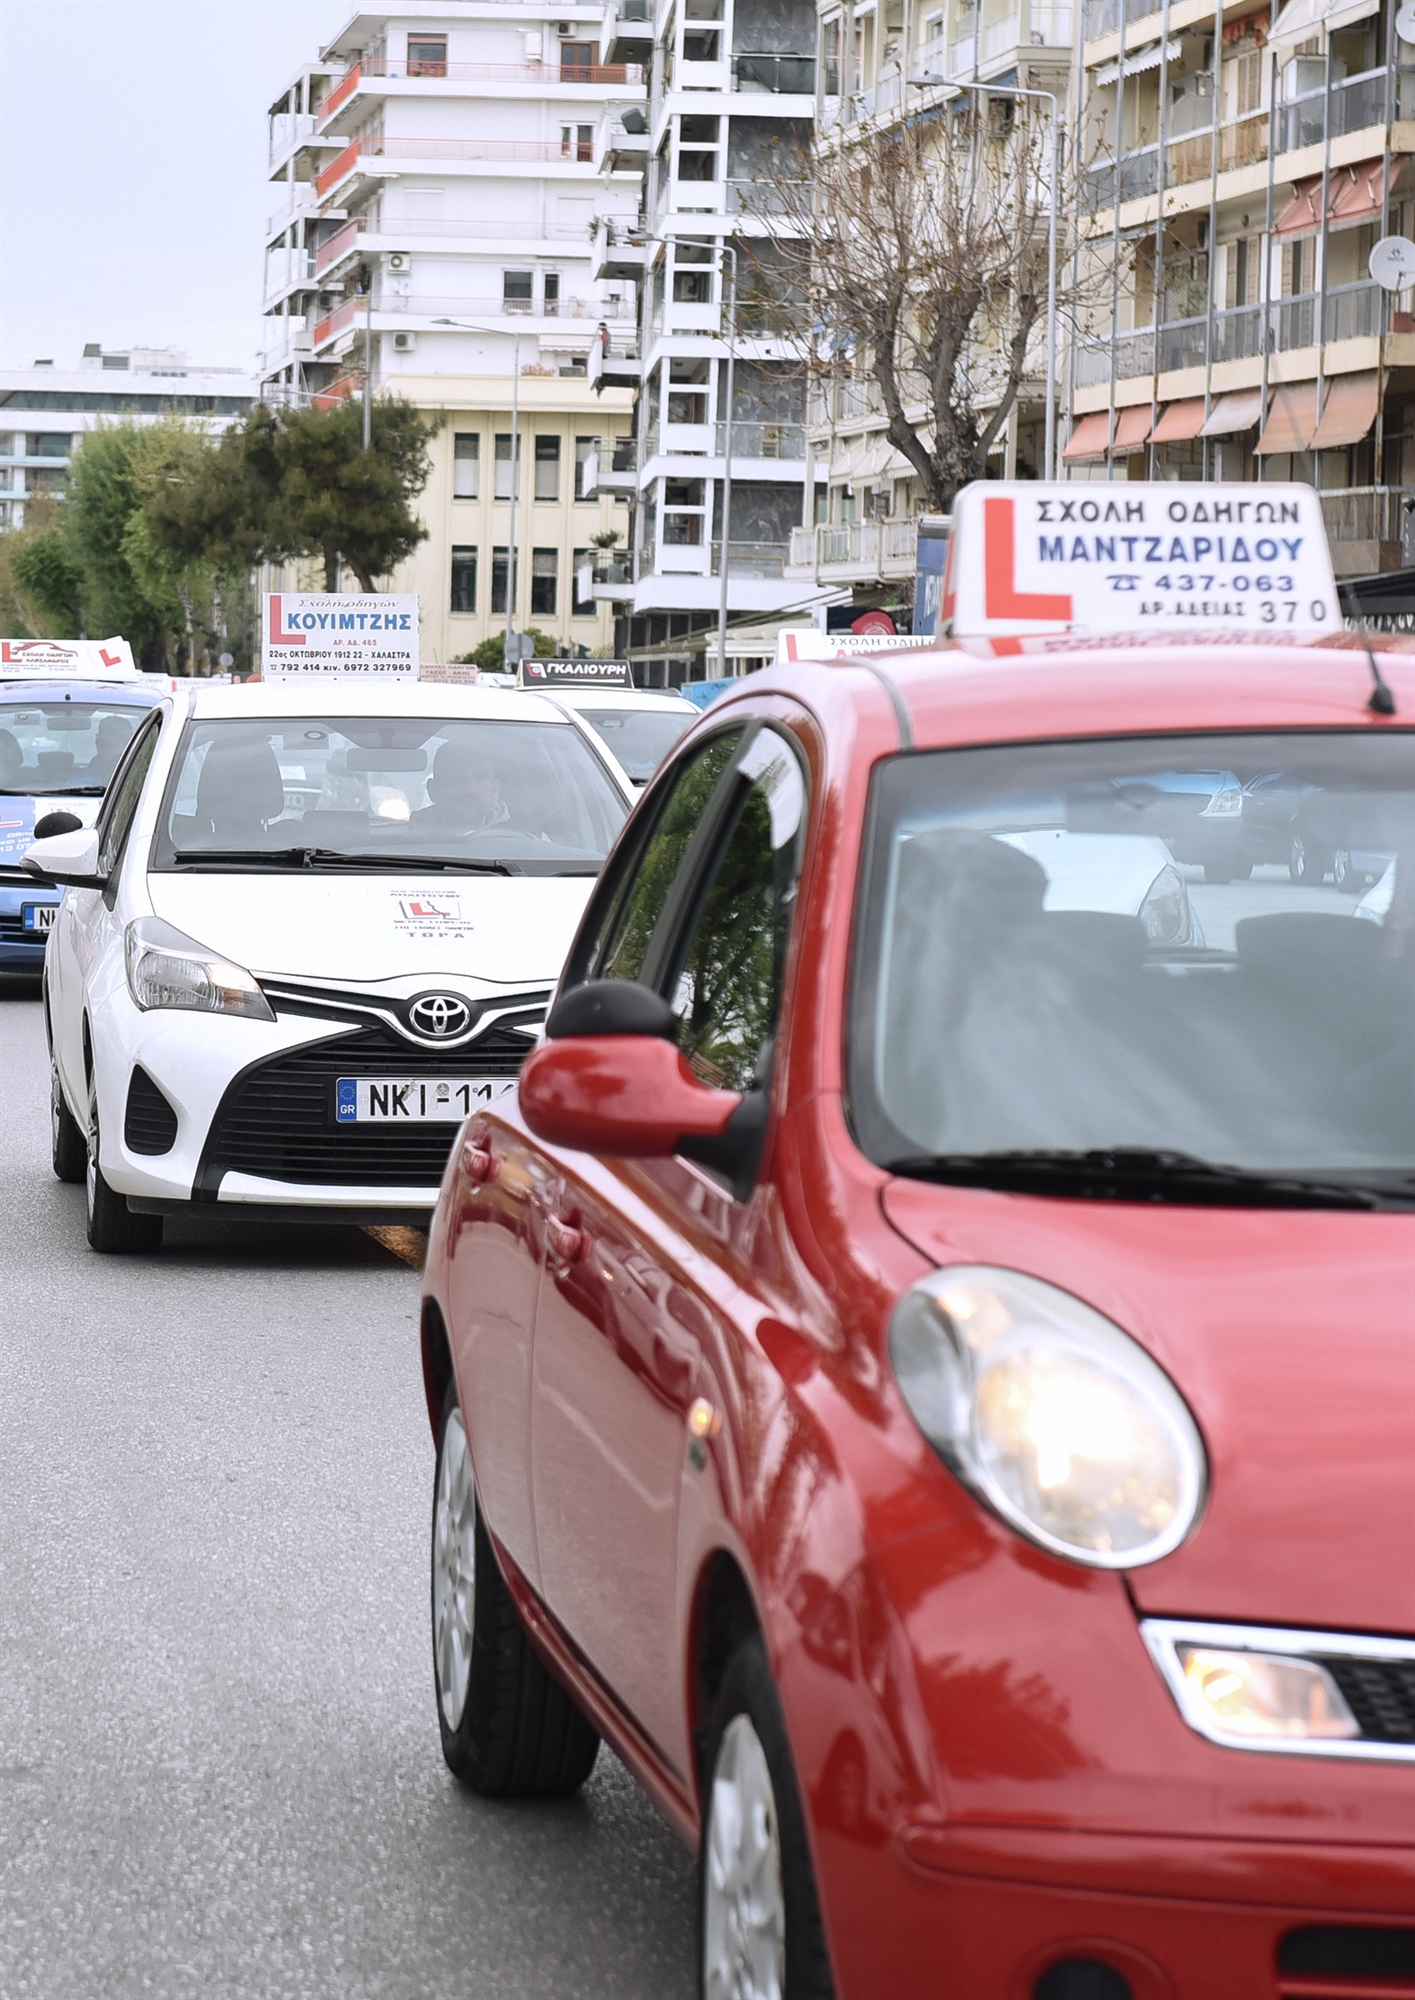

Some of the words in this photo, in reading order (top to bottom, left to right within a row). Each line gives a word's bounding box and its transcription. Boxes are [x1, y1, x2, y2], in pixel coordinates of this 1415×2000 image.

[1037, 500, 1145, 523] ΣΧΟΛΗ
[1168, 500, 1300, 523] ΟΔΗΓΩΝ
[984, 497, 1073, 620] L
[1038, 536, 1304, 563] ΜΑΝΤΖΑΡΙΔΟΥ
[1155, 574, 1294, 592] 437-063
[270, 595, 306, 645] L
[288, 613, 411, 630] ΚΟΥΙΜΤΖΗΣ
[831, 638, 880, 646] ΣΧΟΛΗ
[290, 651, 332, 659] ΟΚΤΩΒΡΙΟΥ
[334, 651, 351, 659] 1912
[353, 651, 362, 659] 22
[547, 663, 626, 675] ΓΚΑΛΙΟΥΡΗ
[370, 1084, 514, 1116] NKI-11
[341, 1105, 355, 1114] GR
